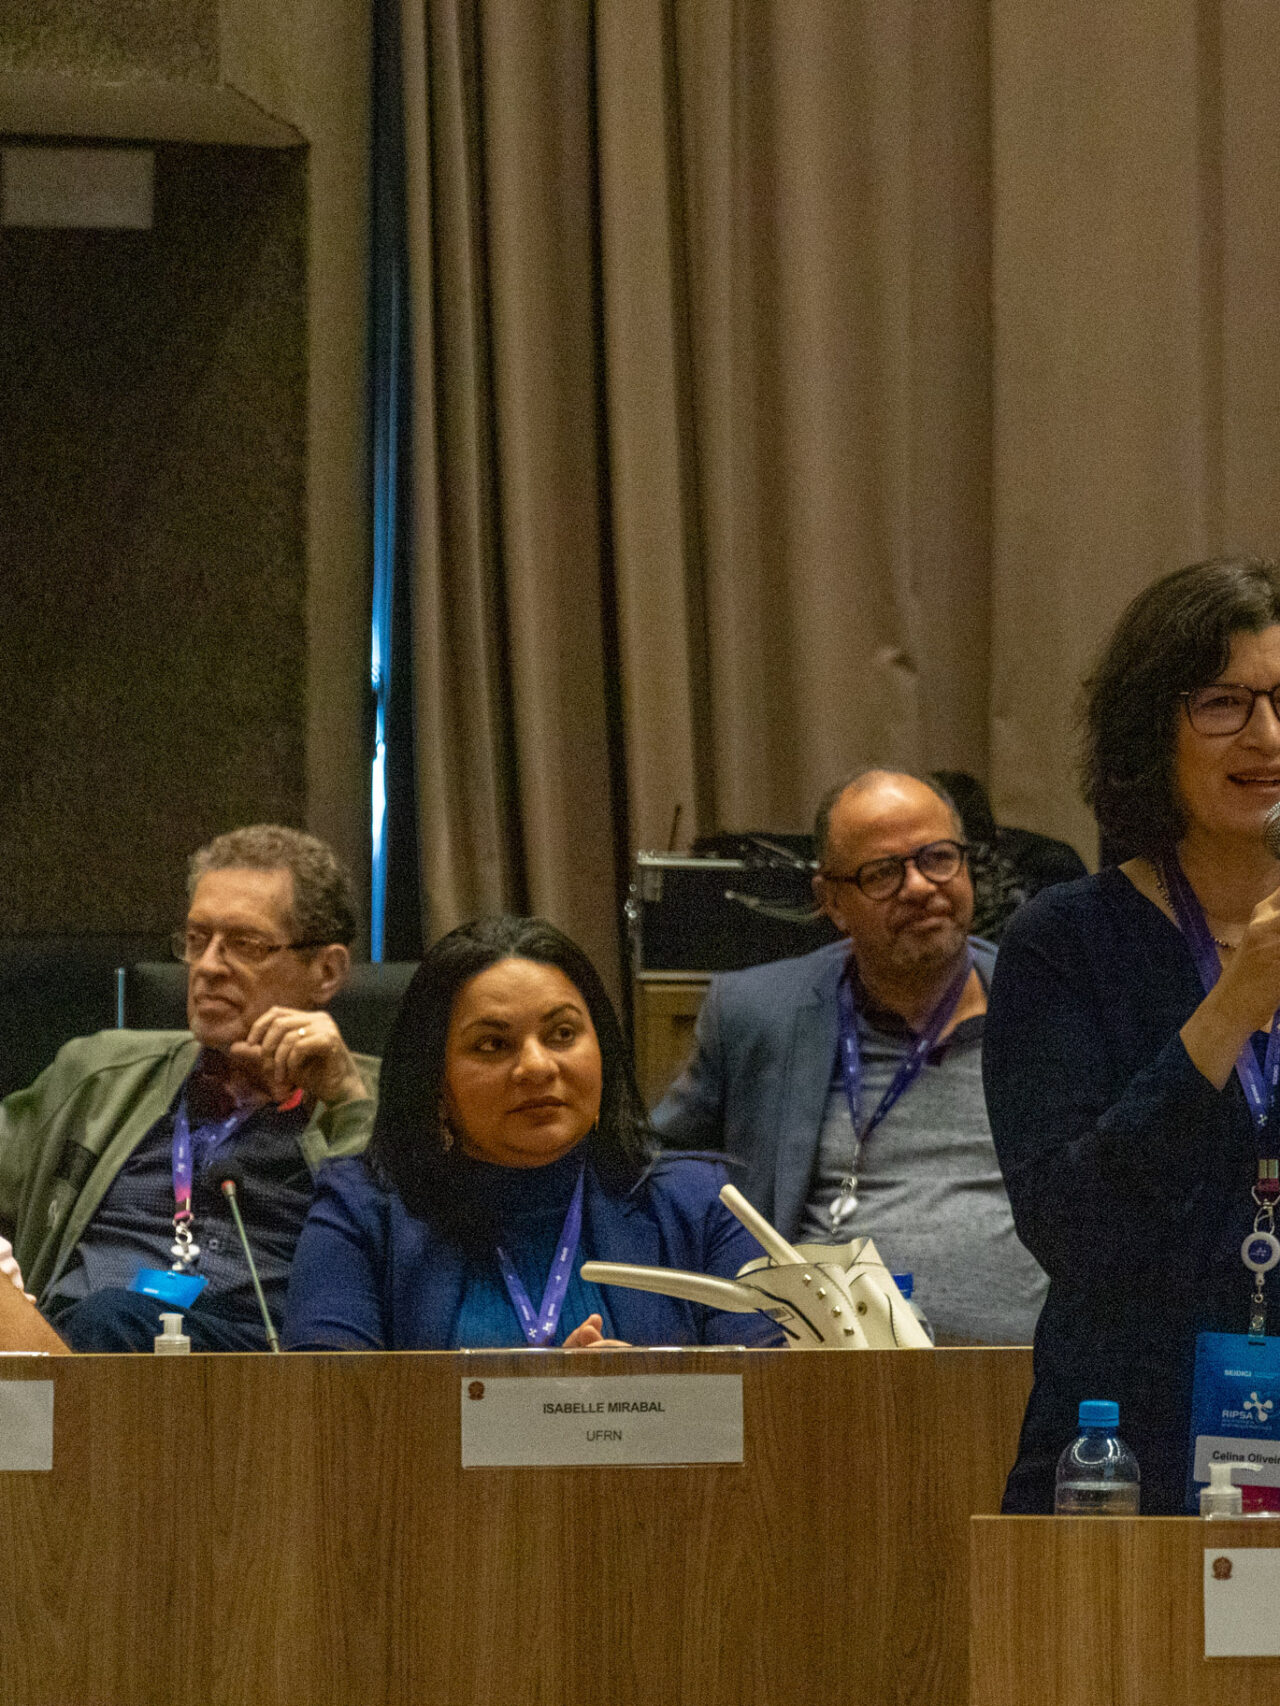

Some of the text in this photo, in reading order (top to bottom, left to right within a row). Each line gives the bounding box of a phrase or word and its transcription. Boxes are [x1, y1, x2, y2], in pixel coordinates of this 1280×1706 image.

[543, 1402, 665, 1414] ISABELLE MIRABAL
[1222, 1409, 1254, 1419] RIPSA
[586, 1429, 622, 1441] UFRN
[1212, 1450, 1245, 1462] Celina
